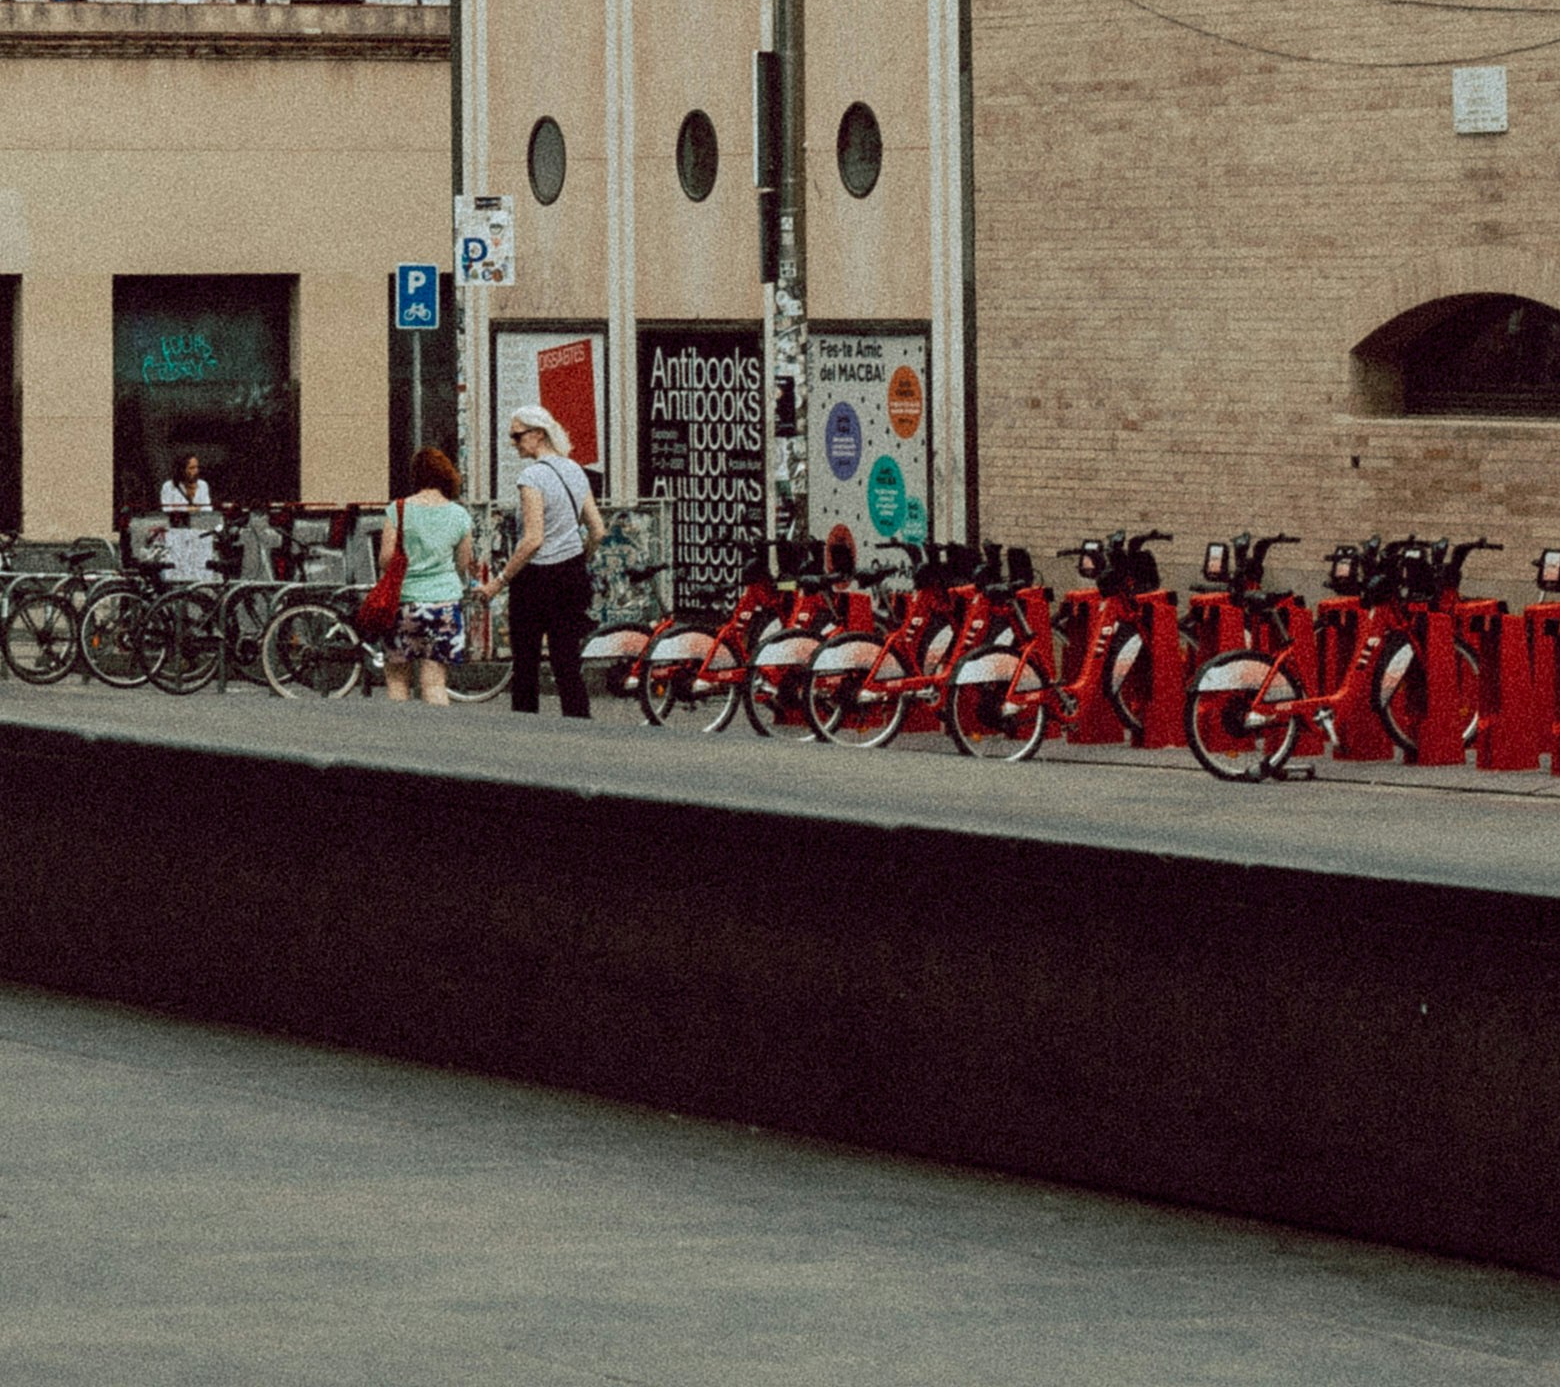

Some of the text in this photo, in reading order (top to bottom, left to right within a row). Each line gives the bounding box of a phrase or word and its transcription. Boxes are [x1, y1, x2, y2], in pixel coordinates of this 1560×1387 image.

[407, 270, 427, 295] P
[819, 339, 853, 358] Fes-te
[650, 346, 761, 389] Antibooks
[820, 363, 886, 382] del MACBA!
